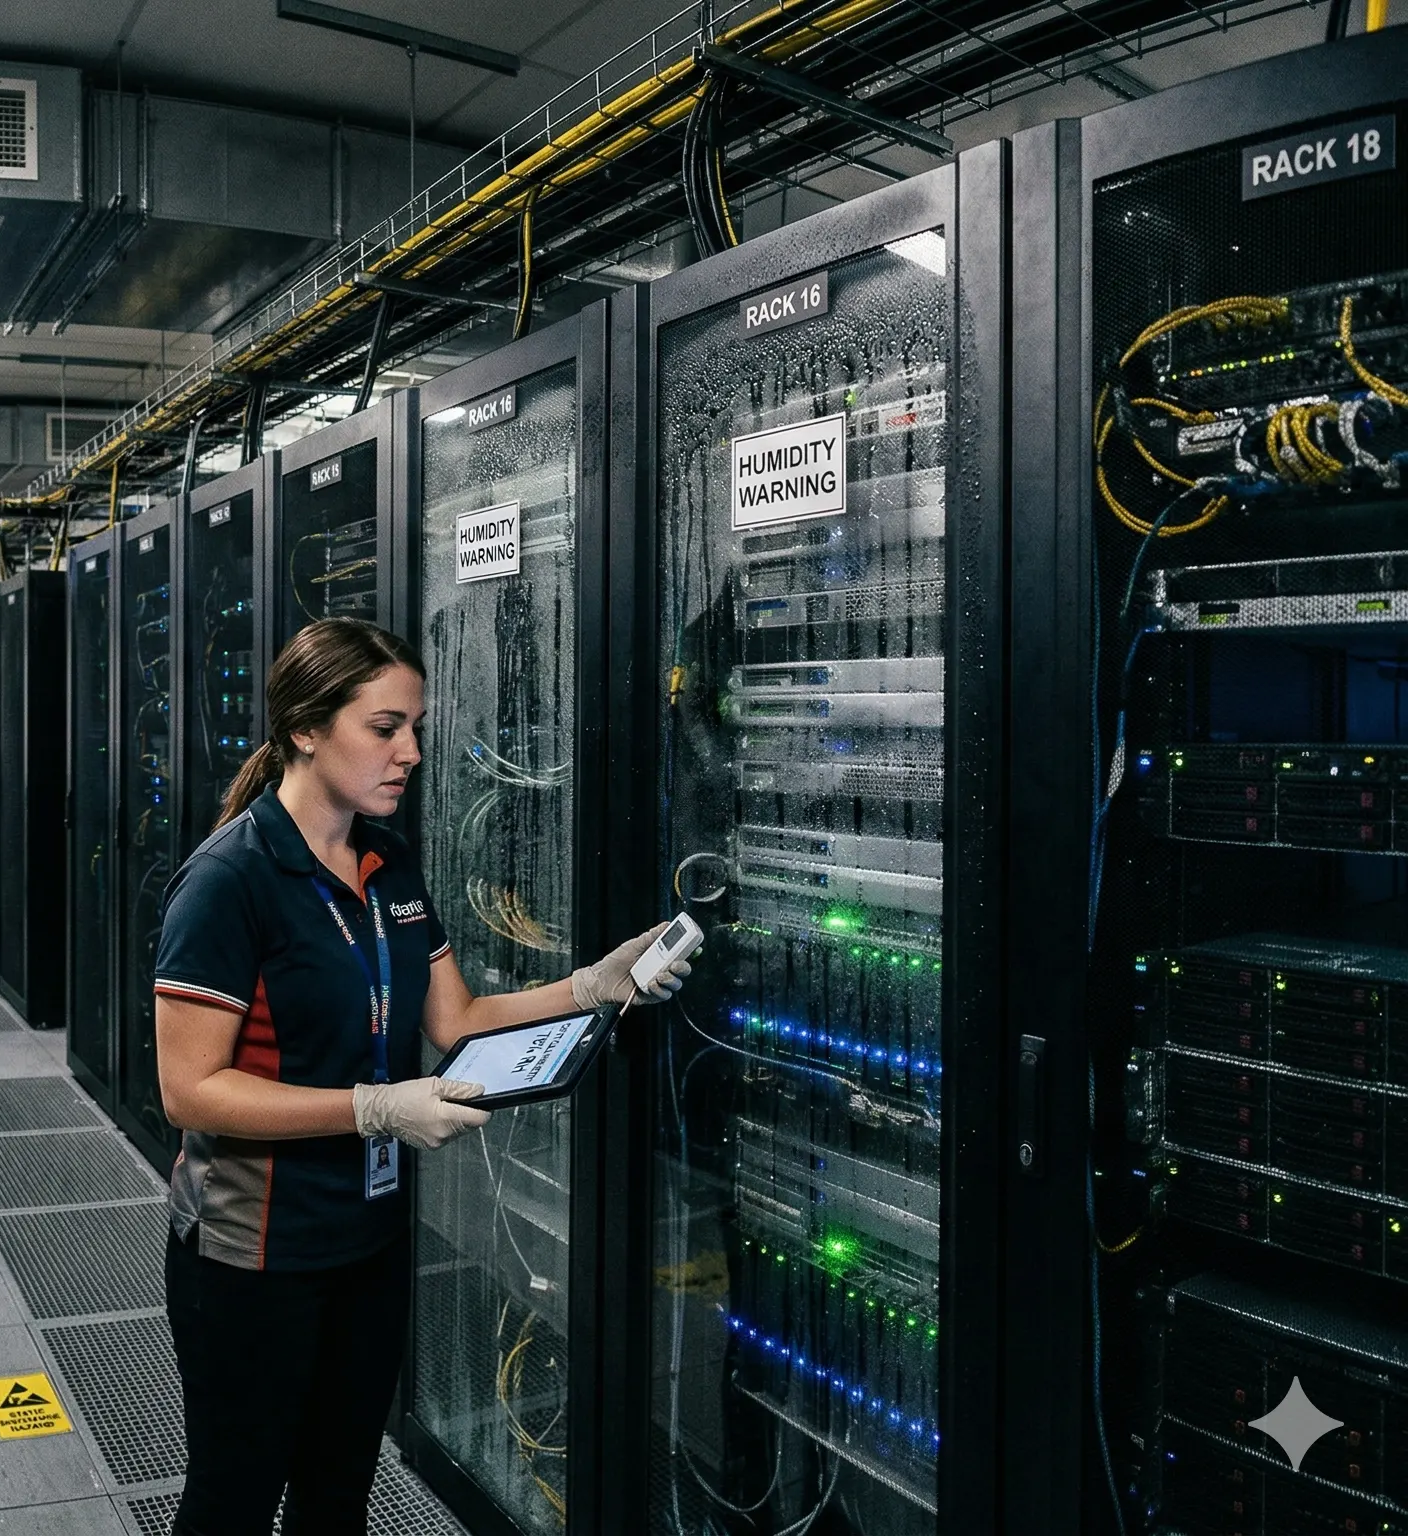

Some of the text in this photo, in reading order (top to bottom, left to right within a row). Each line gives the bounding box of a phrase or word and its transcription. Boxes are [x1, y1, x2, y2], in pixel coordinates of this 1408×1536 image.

[1252, 129, 1381, 186] RACK 18
[746, 283, 821, 329] RACK 16
[468, 394, 512, 427] RACK 16
[739, 437, 836, 478] HUMIDITY
[738, 470, 836, 508] WARNING
[460, 517, 515, 545] HUMIDITY
[459, 542, 515, 568] WARNING
